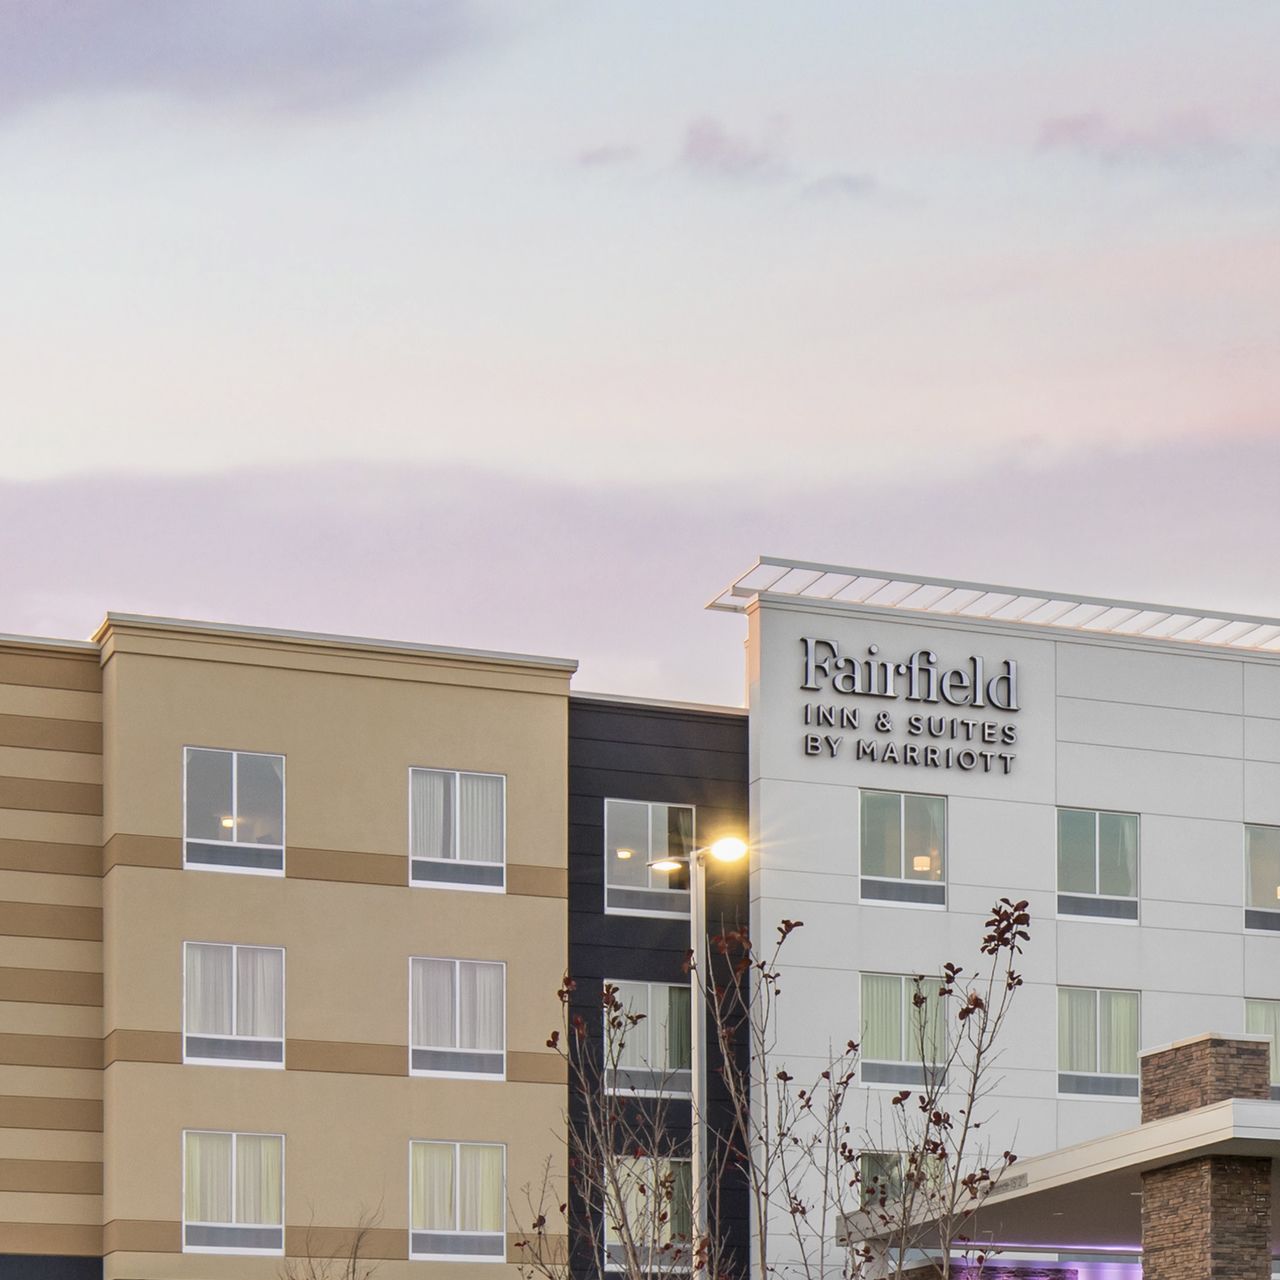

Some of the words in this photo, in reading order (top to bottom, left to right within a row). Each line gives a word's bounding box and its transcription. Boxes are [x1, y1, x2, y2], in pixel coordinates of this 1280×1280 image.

[799, 637, 1020, 711] Fairfield
[804, 703, 859, 729] INN
[875, 711, 894, 732] &
[908, 715, 1017, 744] SUITES
[804, 734, 843, 756] BY
[857, 740, 1016, 773] MARRIOTT
